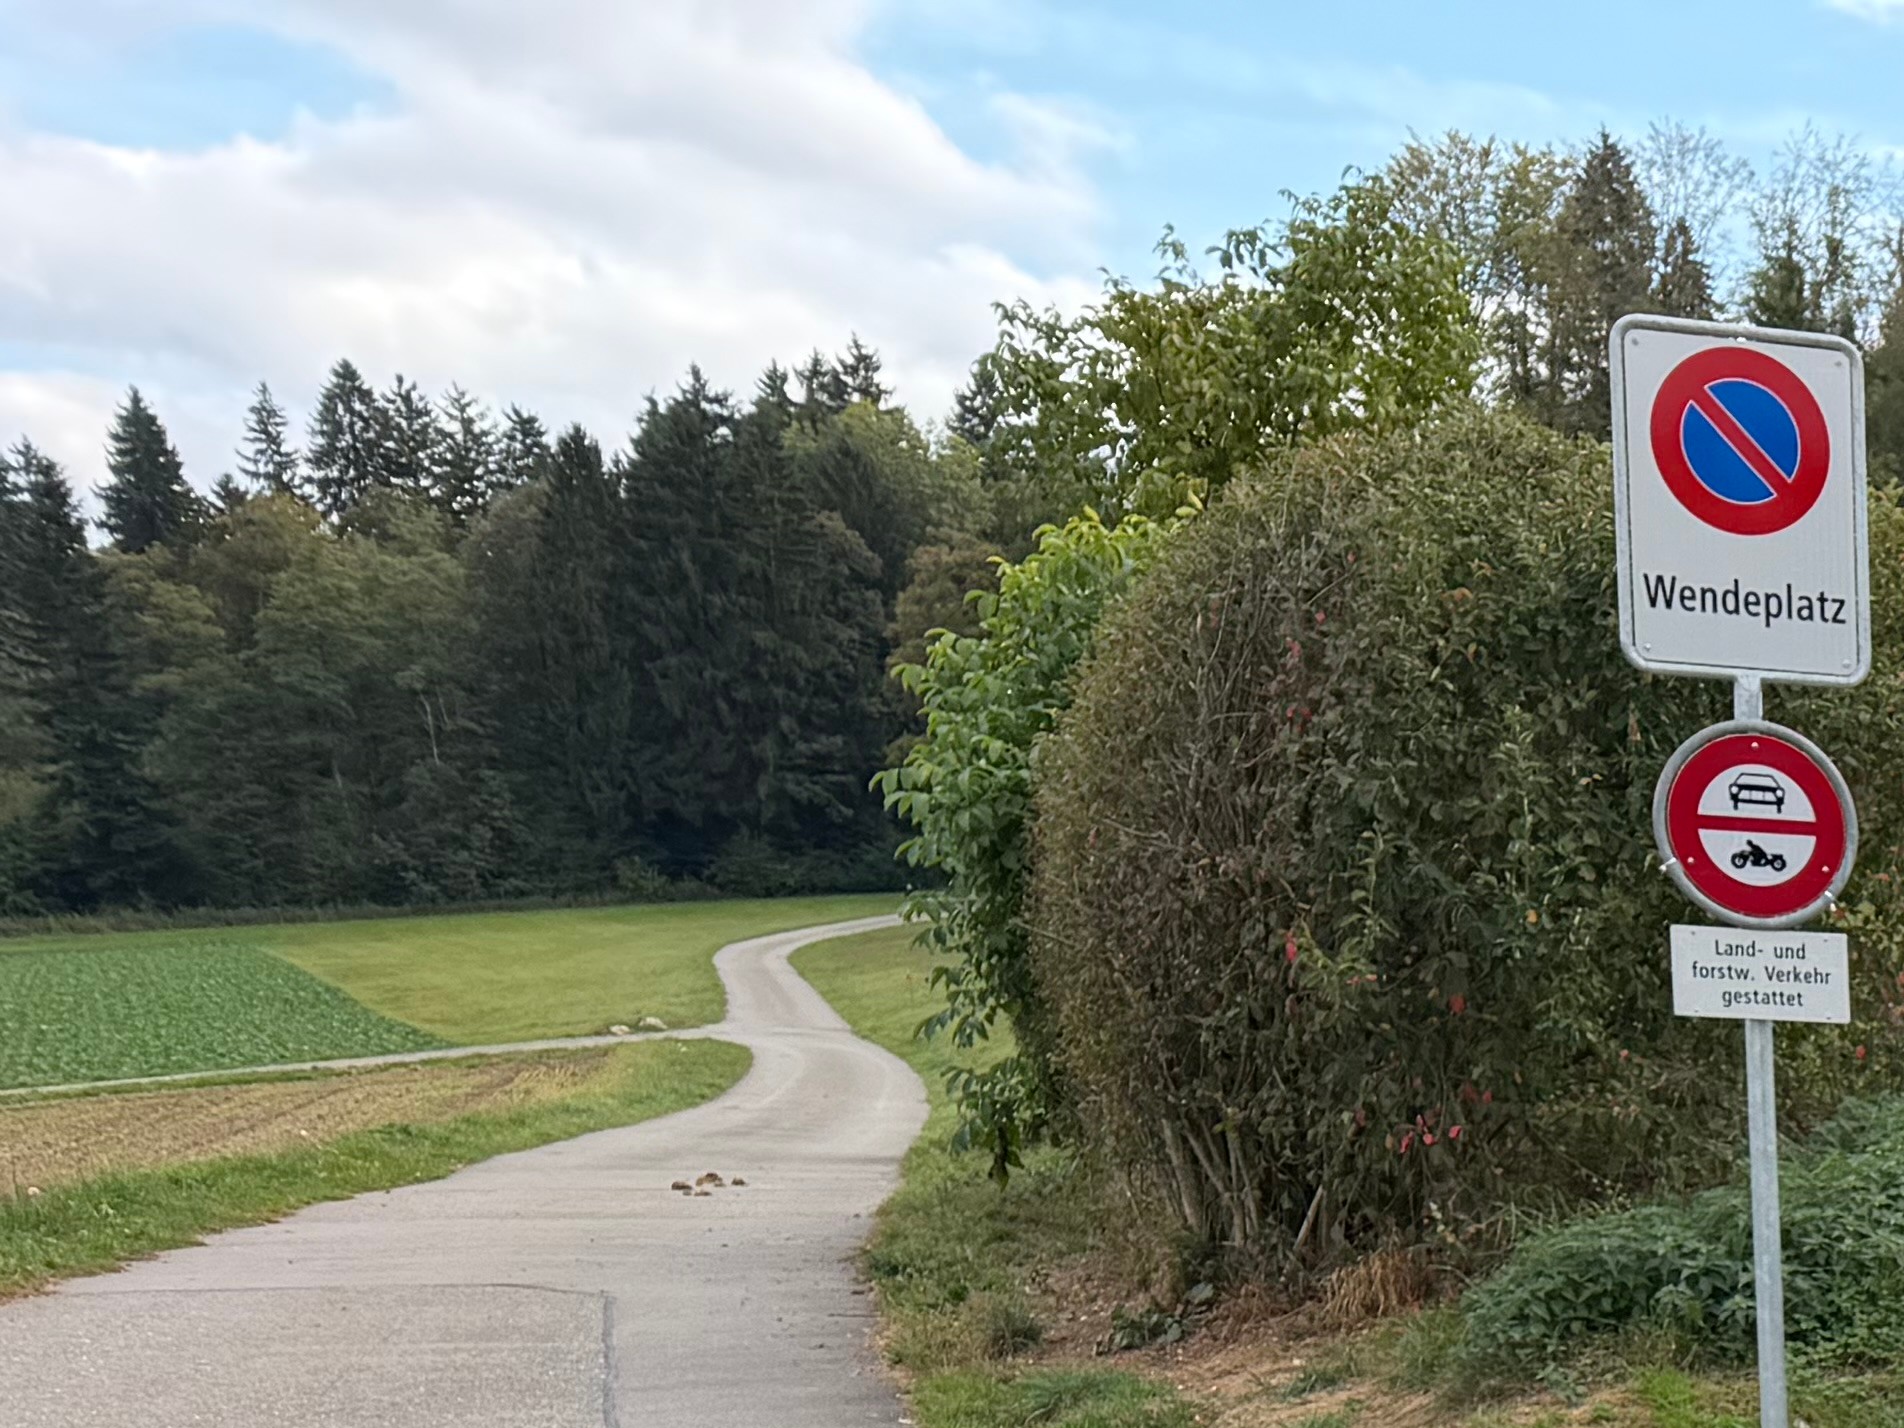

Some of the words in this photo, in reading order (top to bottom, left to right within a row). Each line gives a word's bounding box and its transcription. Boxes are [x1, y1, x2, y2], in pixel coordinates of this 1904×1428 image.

[1643, 573, 1847, 628] Wendeplatz
[1715, 939, 1764, 957] Land-
[1774, 944, 1806, 960] und
[1692, 961, 1755, 981] forstw.
[1764, 965, 1832, 985] Verkehr
[1722, 989, 1804, 1008] gestattet
